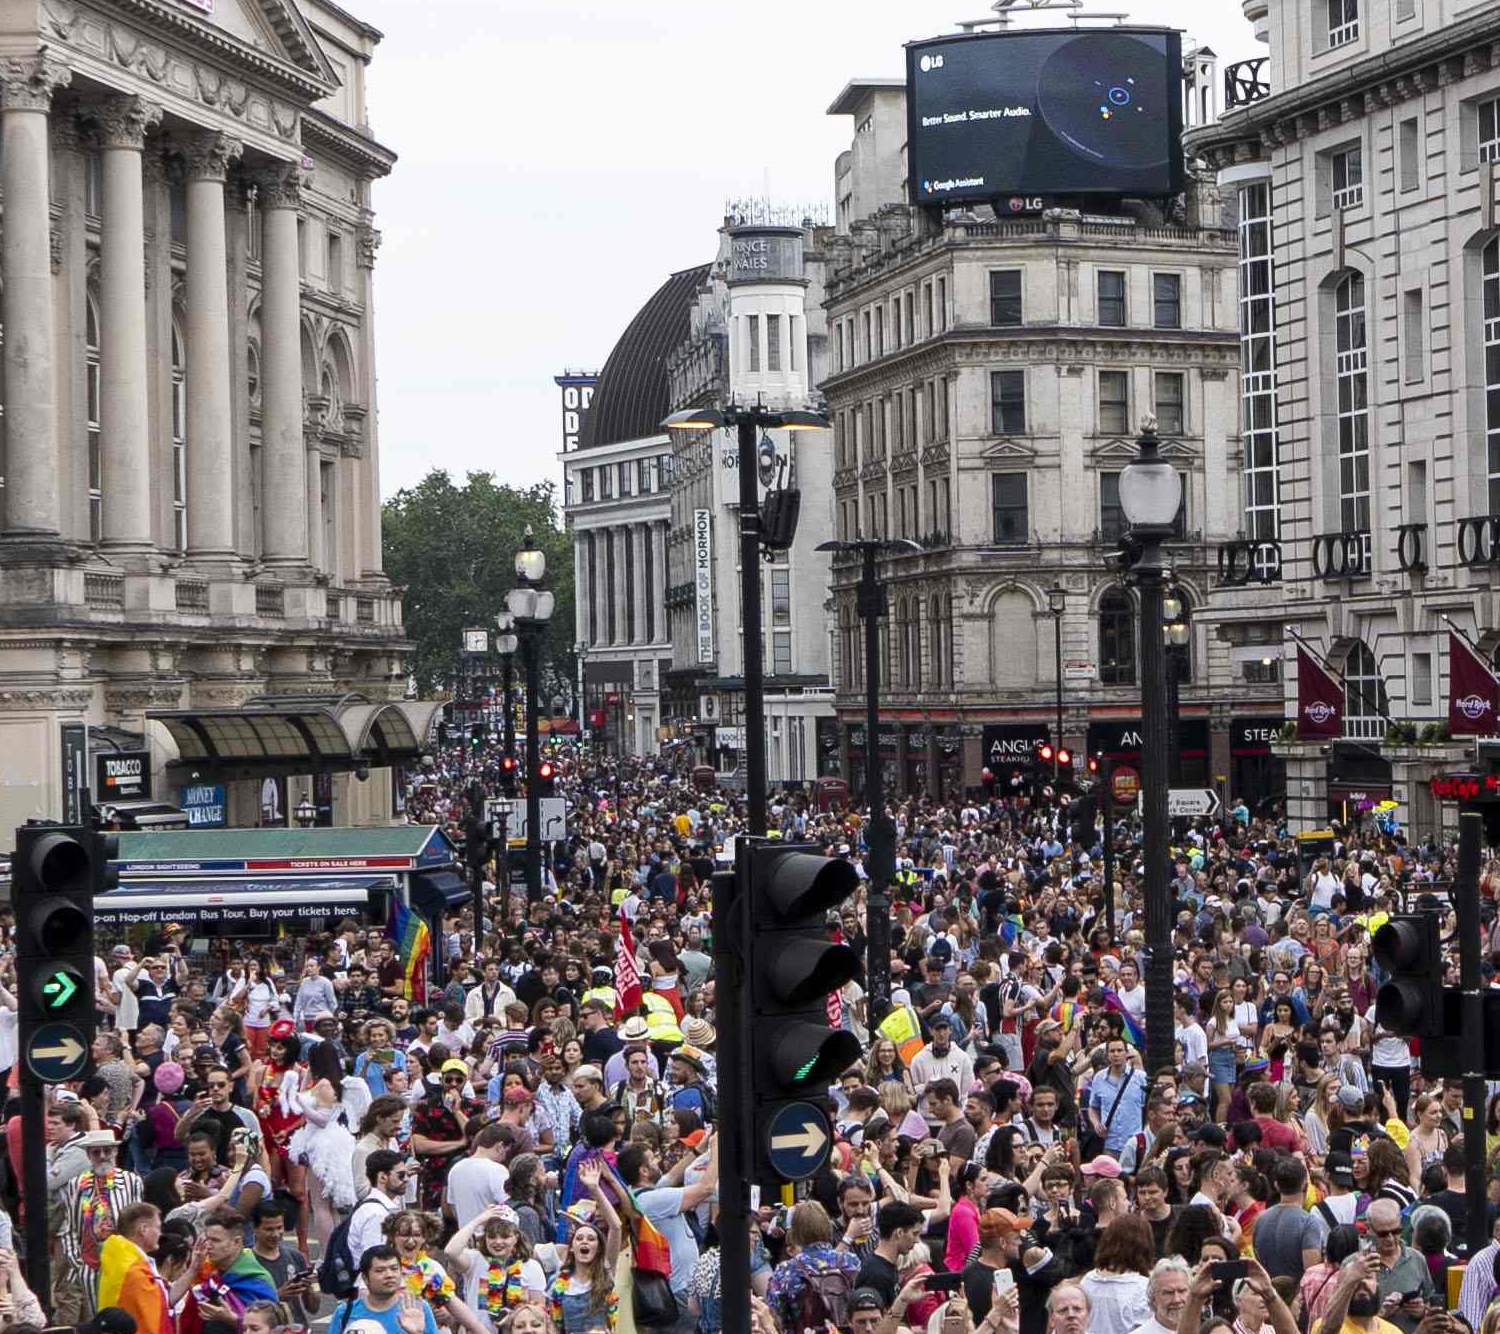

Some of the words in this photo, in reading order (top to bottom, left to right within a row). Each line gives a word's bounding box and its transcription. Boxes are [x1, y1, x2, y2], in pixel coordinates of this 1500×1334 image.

[931, 56, 943, 68] LG
[944, 113, 967, 123] Sound.
[970, 110, 1003, 121] Smarter
[1004, 107, 1032, 117] Audio.
[934, 181, 955, 192] Google
[956, 177, 984, 188] Assistant
[1026, 198, 1043, 210] LG
[733, 258, 769, 270] WALES
[698, 511, 709, 569] MORMON
[699, 572, 710, 590] OF
[700, 595, 710, 631] BOOK
[701, 635, 712, 660] THE
[1304, 704, 1321, 715] Hard
[1321, 704, 1336, 717] Rock
[1456, 698, 1473, 710] Hard
[1473, 699, 1492, 712] Rock
[106, 759, 141, 776] TOBACCO
[991, 755, 1031, 764] STEAKHO
[66, 743, 75, 825] TOBAC
[186, 786, 217, 805] MONEY
[189, 806, 224, 825] CHANGE
[156, 862, 200, 870] SIGHTSEEING
[290, 861, 317, 869] TICKETS
[350, 859, 367, 867] HERE
[119, 911, 157, 923] Hop-off
[160, 910, 197, 922] London
[201, 910, 219, 919] Bus
[250, 907, 267, 919] Buy
[271, 908, 295, 919] your
[299, 905, 332, 916] tickets
[335, 905, 359, 915] here.
